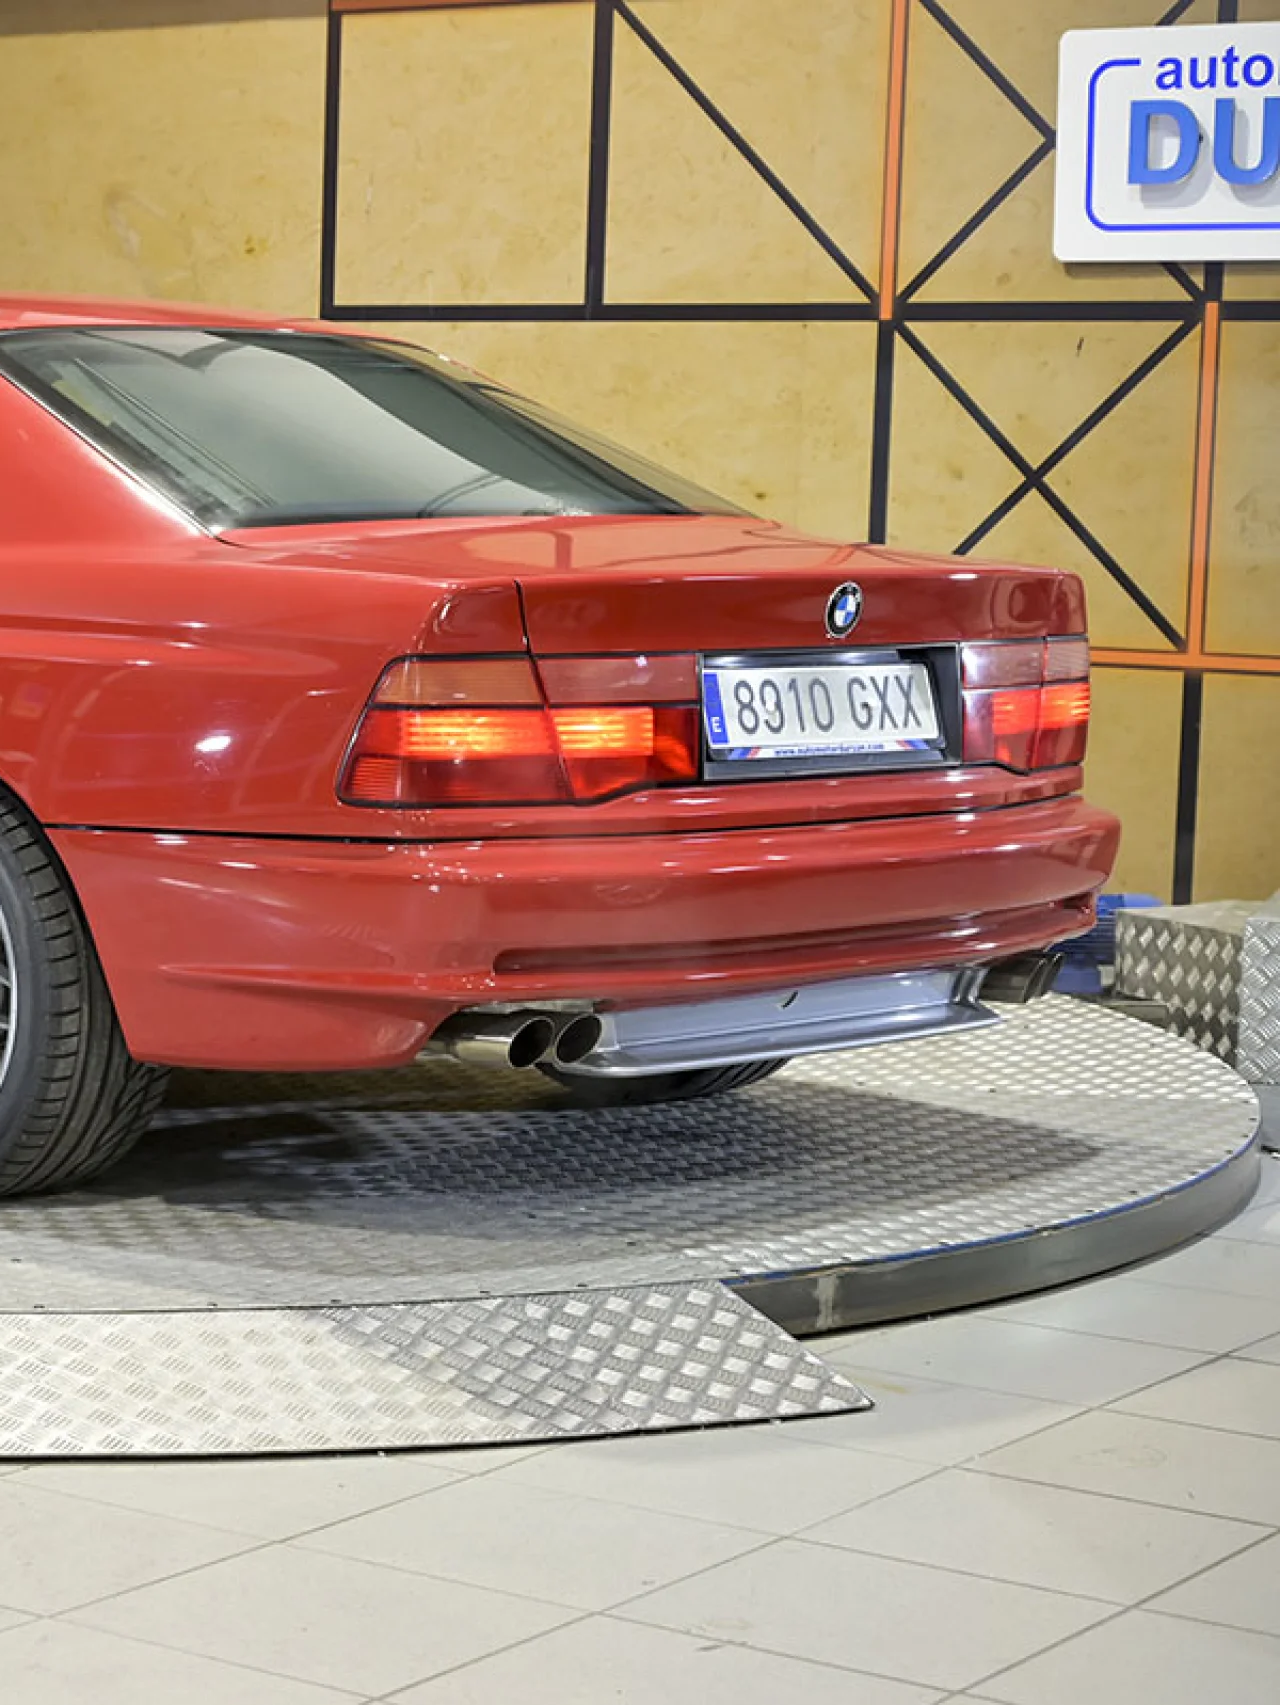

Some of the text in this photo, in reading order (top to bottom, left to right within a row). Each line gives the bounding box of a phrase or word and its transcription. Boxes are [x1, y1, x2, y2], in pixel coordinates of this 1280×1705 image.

[1155, 45, 1280, 90] auto
[1127, 96, 1280, 185] DU
[710, 716, 722, 733] E
[734, 675, 922, 735] 8910 GXX
